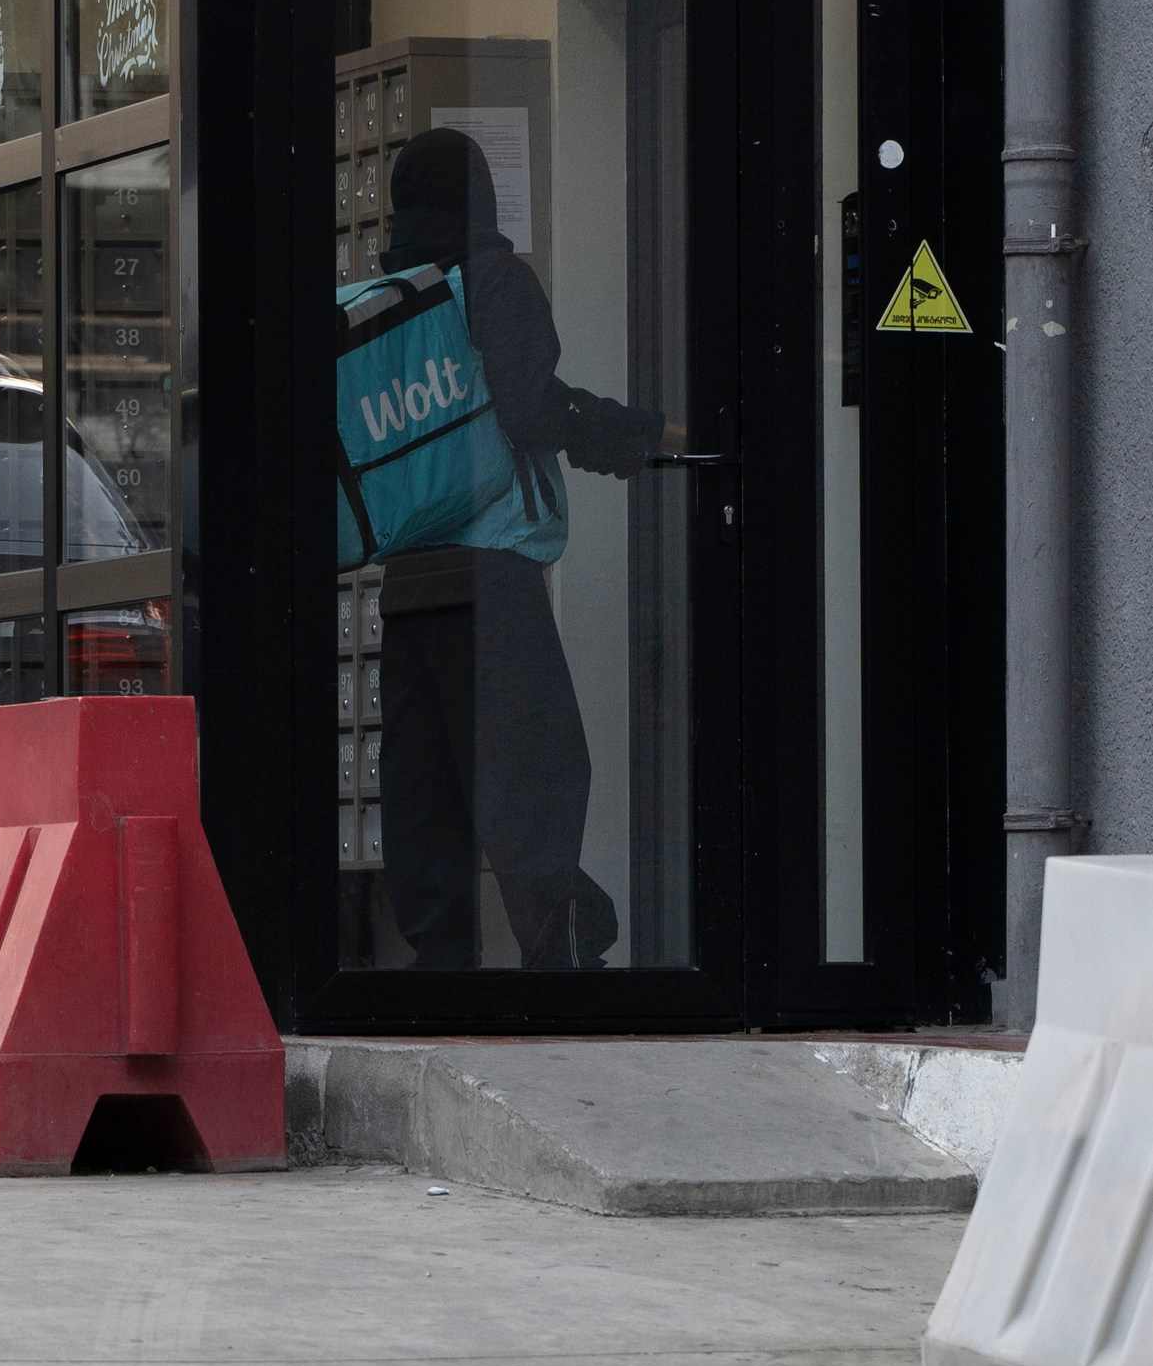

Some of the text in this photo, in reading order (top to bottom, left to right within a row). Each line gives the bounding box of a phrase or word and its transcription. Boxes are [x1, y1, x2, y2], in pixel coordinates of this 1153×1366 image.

[366, 93, 376, 112] 10
[395, 86, 405, 103] 11
[339, 101, 346, 119] 9
[338, 172, 348, 191] 20
[366, 166, 376, 184] 21
[114, 188, 139, 205] 16
[366, 237, 378, 256] 32
[113, 258, 139, 276] 27
[891, 315, 913, 324] ვიდე
[115, 328, 140, 346] 38
[115, 399, 140, 416] 49
[360, 357, 468, 442] Wolt
[116, 469, 141, 486] 60
[340, 601, 351, 620] 86
[369, 598, 379, 616] 87
[118, 609, 143, 625] 82
[118, 679, 144, 696] 93
[340, 673, 351, 691] 97
[369, 669, 380, 689] 98
[339, 744, 354, 763] 108
